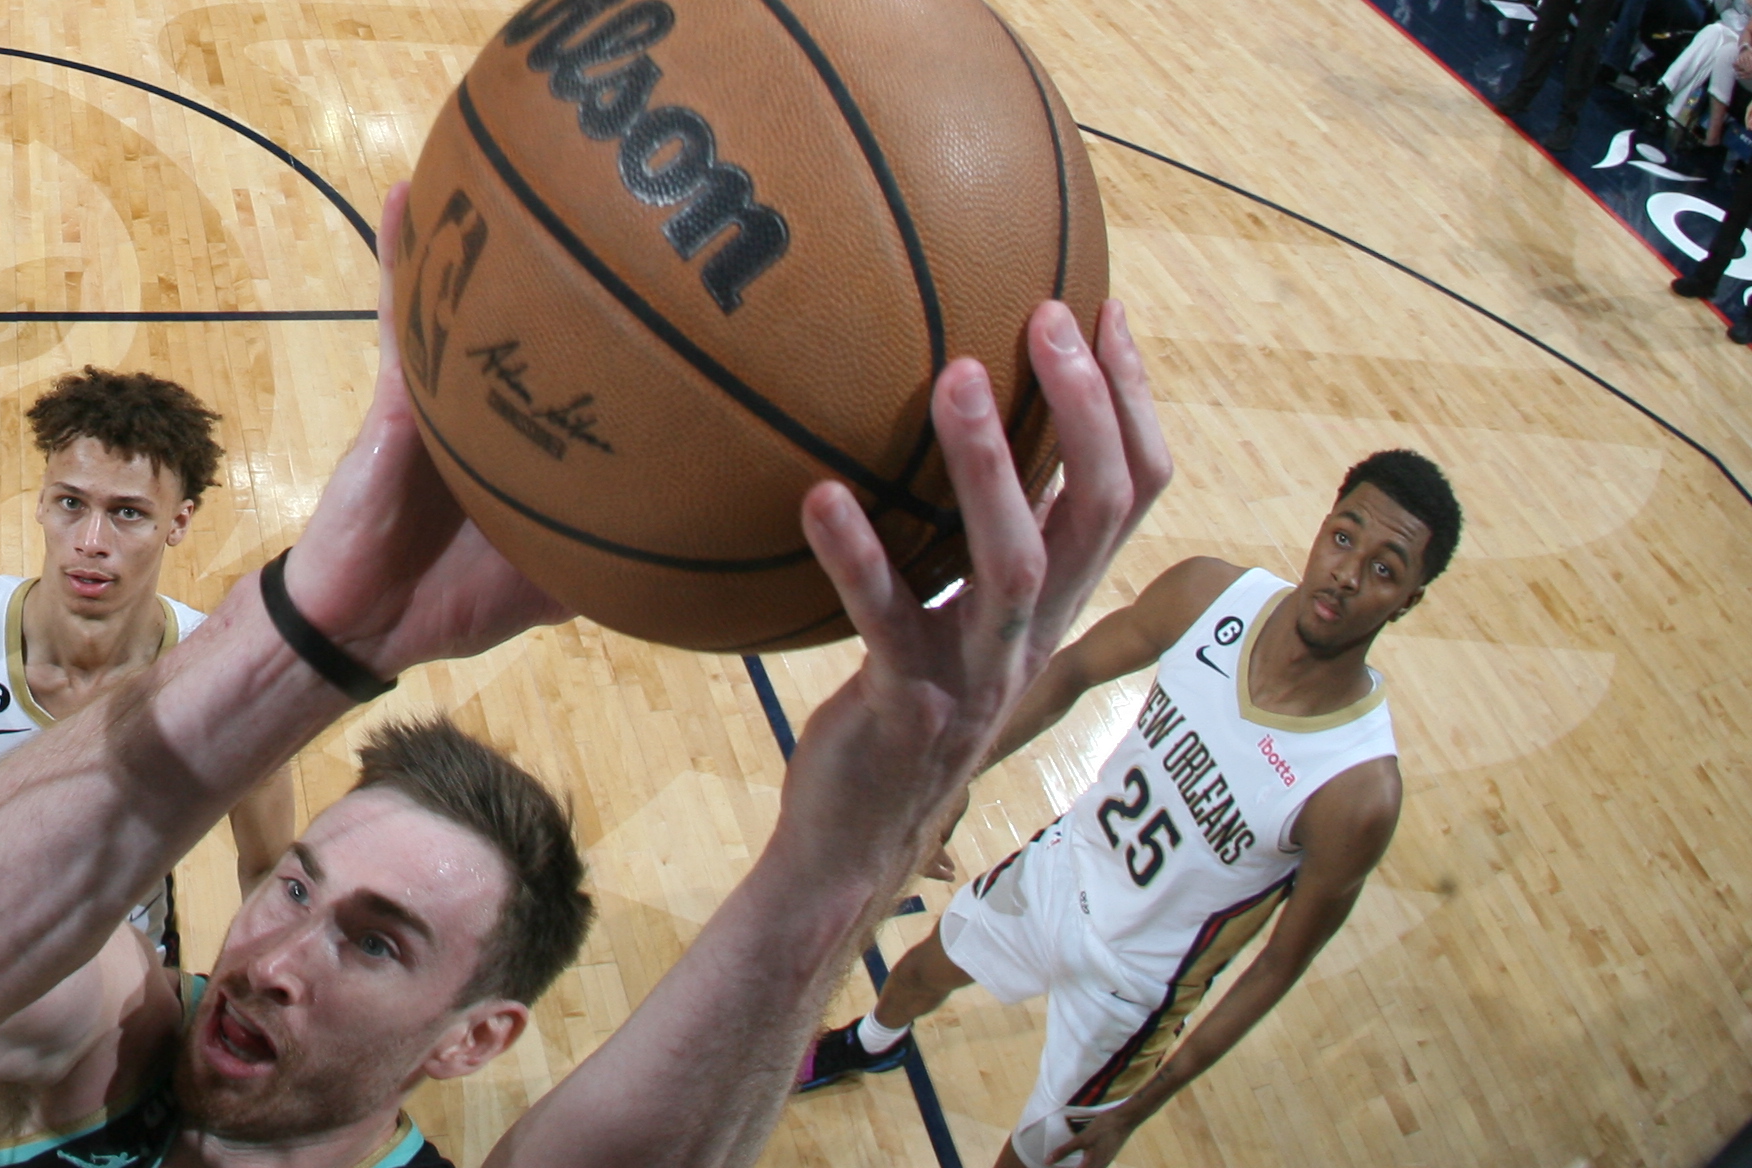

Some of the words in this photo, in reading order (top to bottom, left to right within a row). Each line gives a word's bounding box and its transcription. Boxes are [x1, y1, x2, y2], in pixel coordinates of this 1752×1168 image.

[1137, 678, 1186, 749] EW
[1162, 729, 1257, 868] ORLEANS
[1255, 733, 1297, 788] ibotta
[1096, 766, 1184, 888] 25
